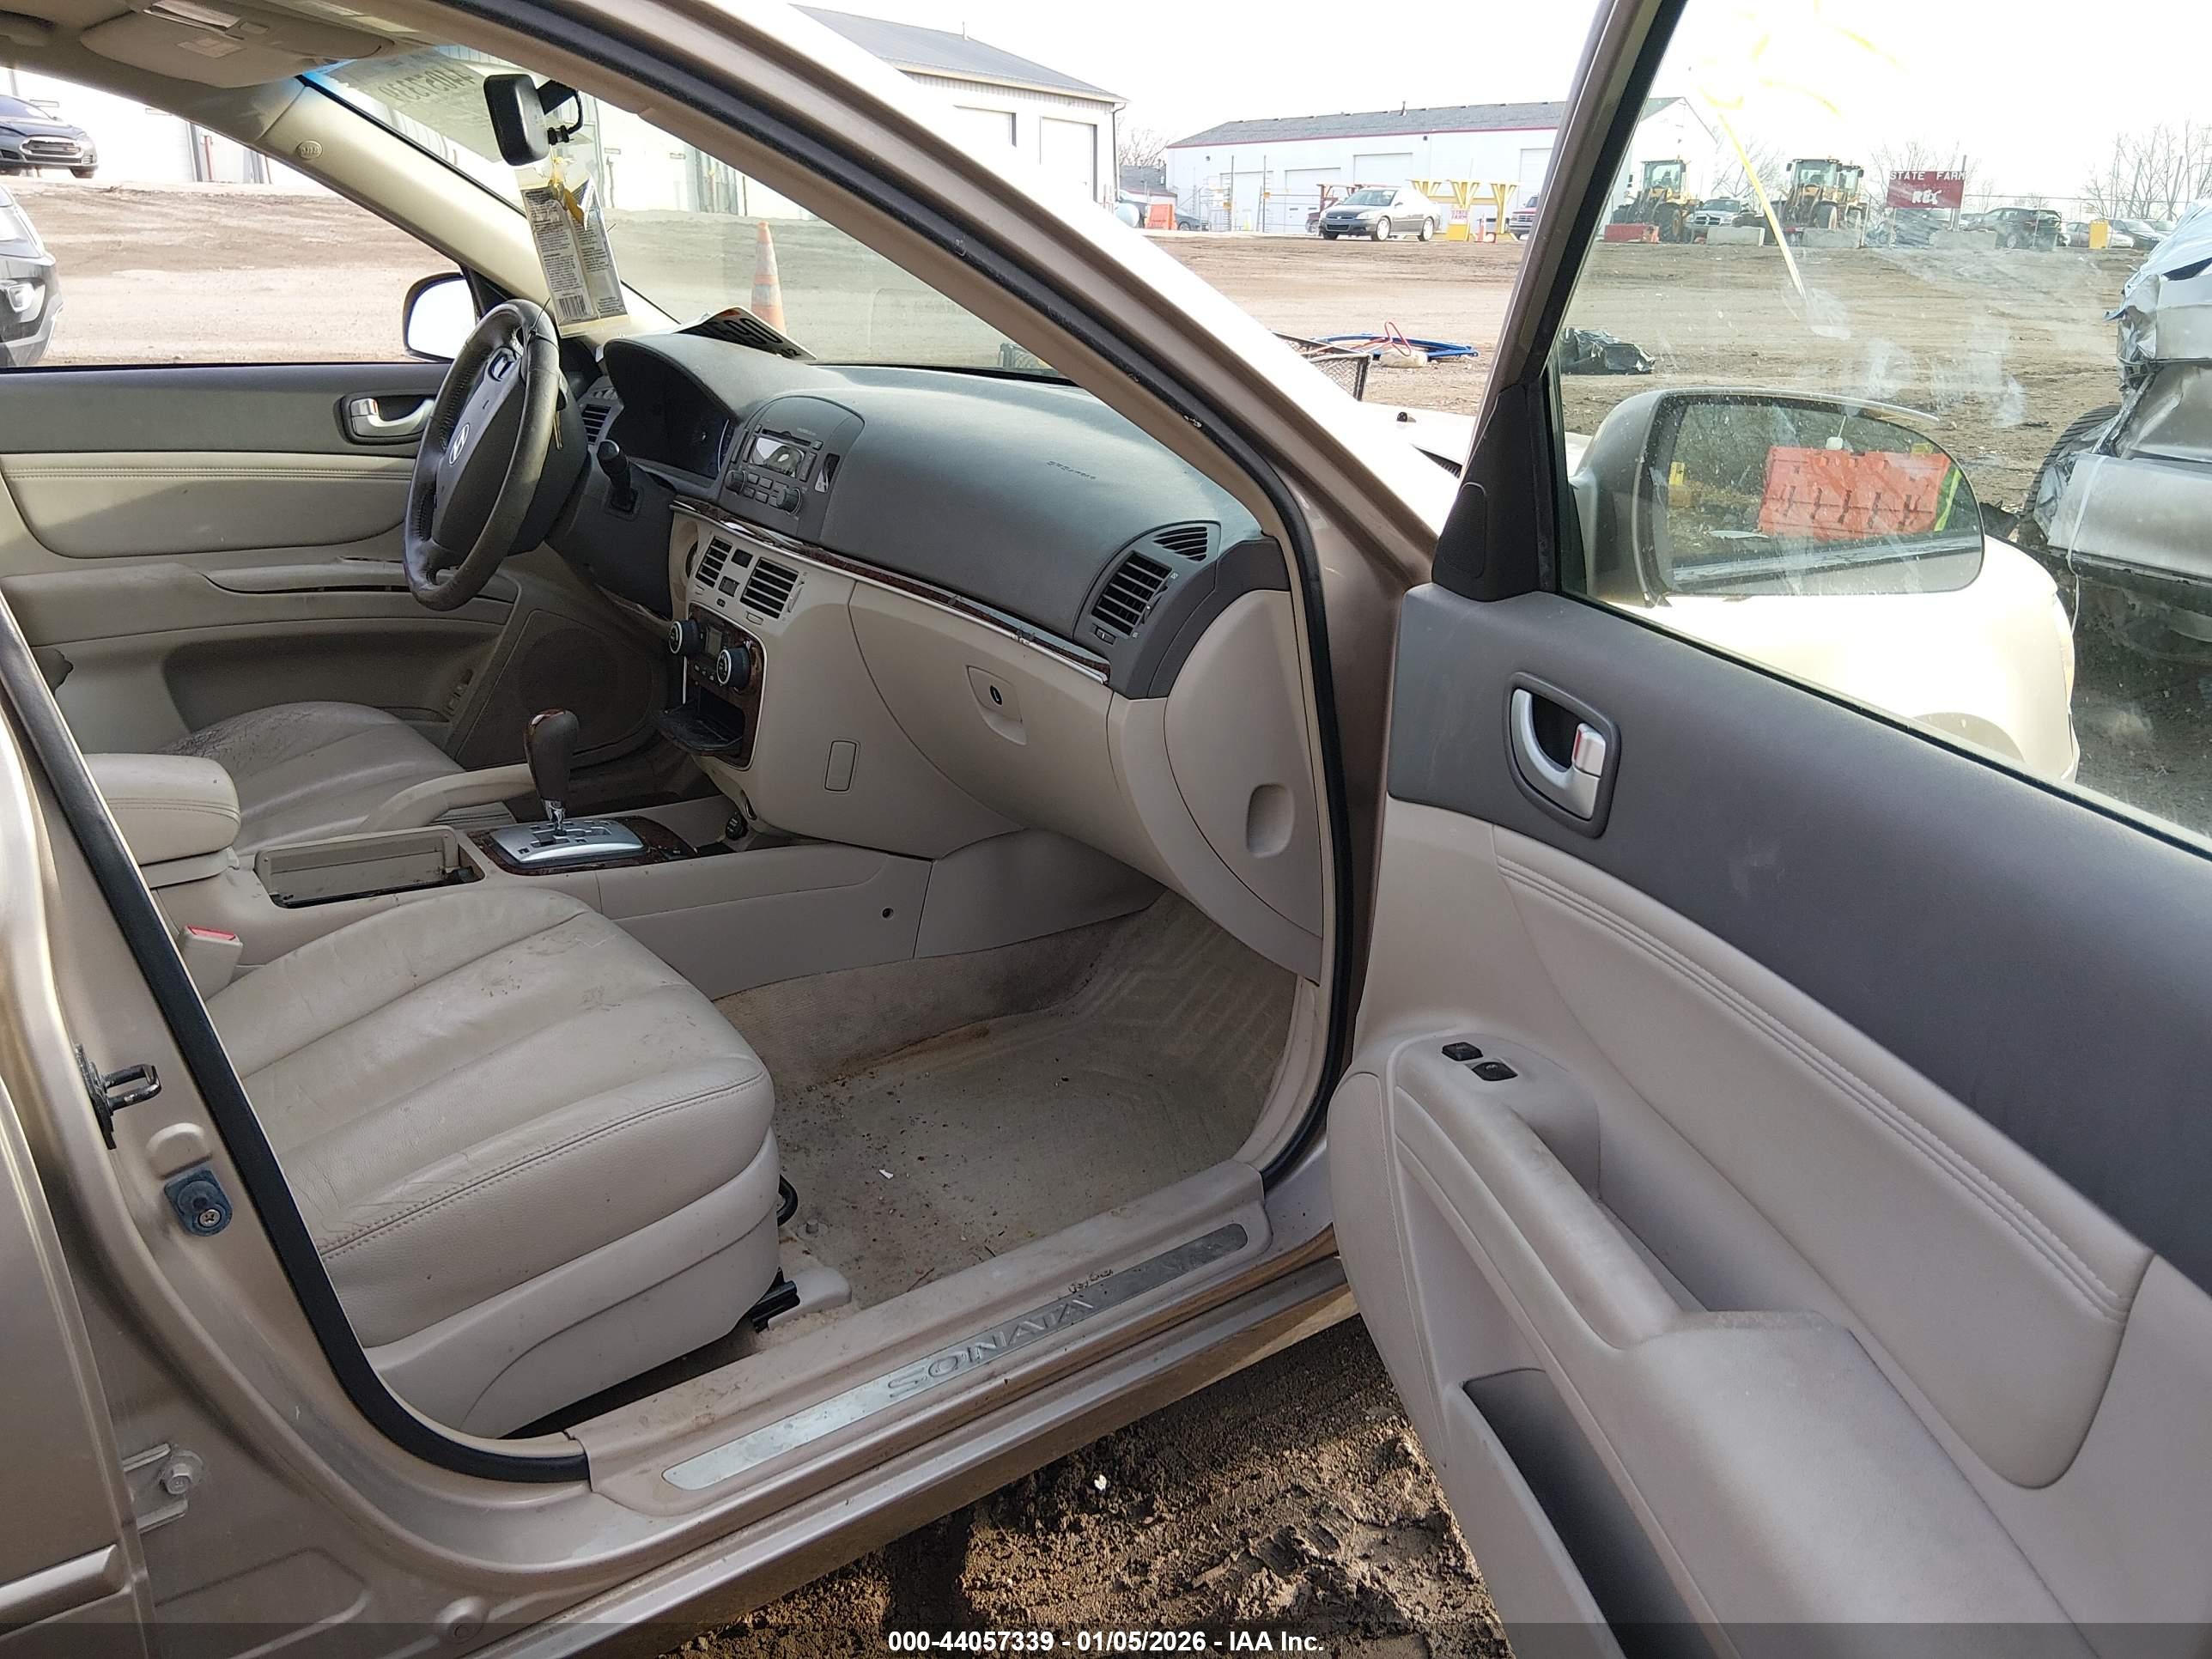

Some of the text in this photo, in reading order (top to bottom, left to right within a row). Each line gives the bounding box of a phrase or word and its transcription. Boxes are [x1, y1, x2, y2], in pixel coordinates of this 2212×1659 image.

[1889, 171, 1966, 181] STATE FARM
[886, 1298, 1095, 1398] SONATA
